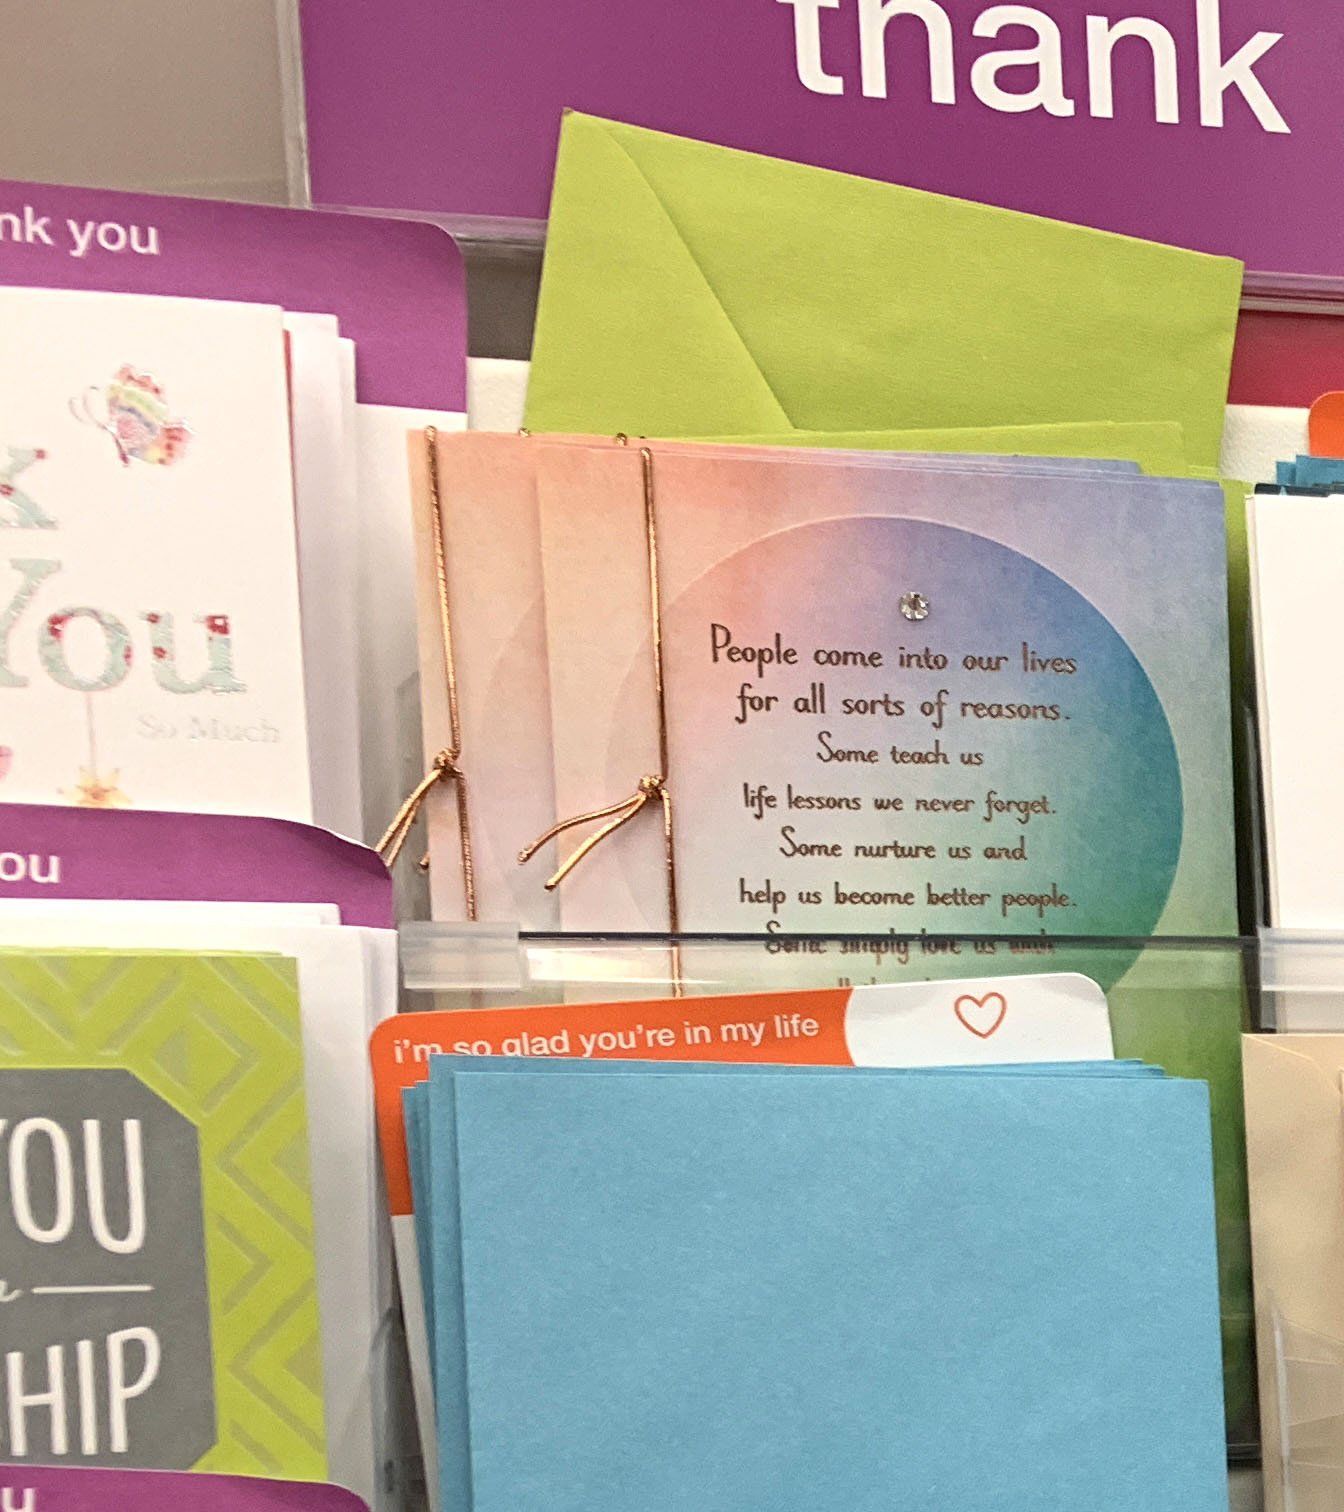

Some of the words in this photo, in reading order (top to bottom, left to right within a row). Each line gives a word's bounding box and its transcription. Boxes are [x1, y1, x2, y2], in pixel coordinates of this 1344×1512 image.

[776, 0, 1291, 133] thank
[67, 220, 159, 257] you
[711, 623, 798, 678] People
[814, 650, 883, 668] come
[899, 647, 948, 670] into
[963, 655, 1008, 671] our
[1022, 642, 1077, 674] lives
[735, 683, 778, 724] for
[794, 683, 825, 714] all
[842, 694, 904, 716] sorts
[920, 689, 949, 729] of
[961, 703, 1070, 720] reasons.
[817, 731, 878, 763] Some
[890, 739, 950, 764] teach
[960, 753, 983, 766] us
[743, 783, 777, 820] life
[787, 784, 861, 810] lessons
[874, 798, 903, 811] we
[916, 799, 975, 812] never
[984, 790, 1056, 824] forget.
[579, 1019, 677, 1056] you're
[684, 1022, 711, 1044] in
[719, 1018, 768, 1048] my
[775, 1014, 818, 1038] life
